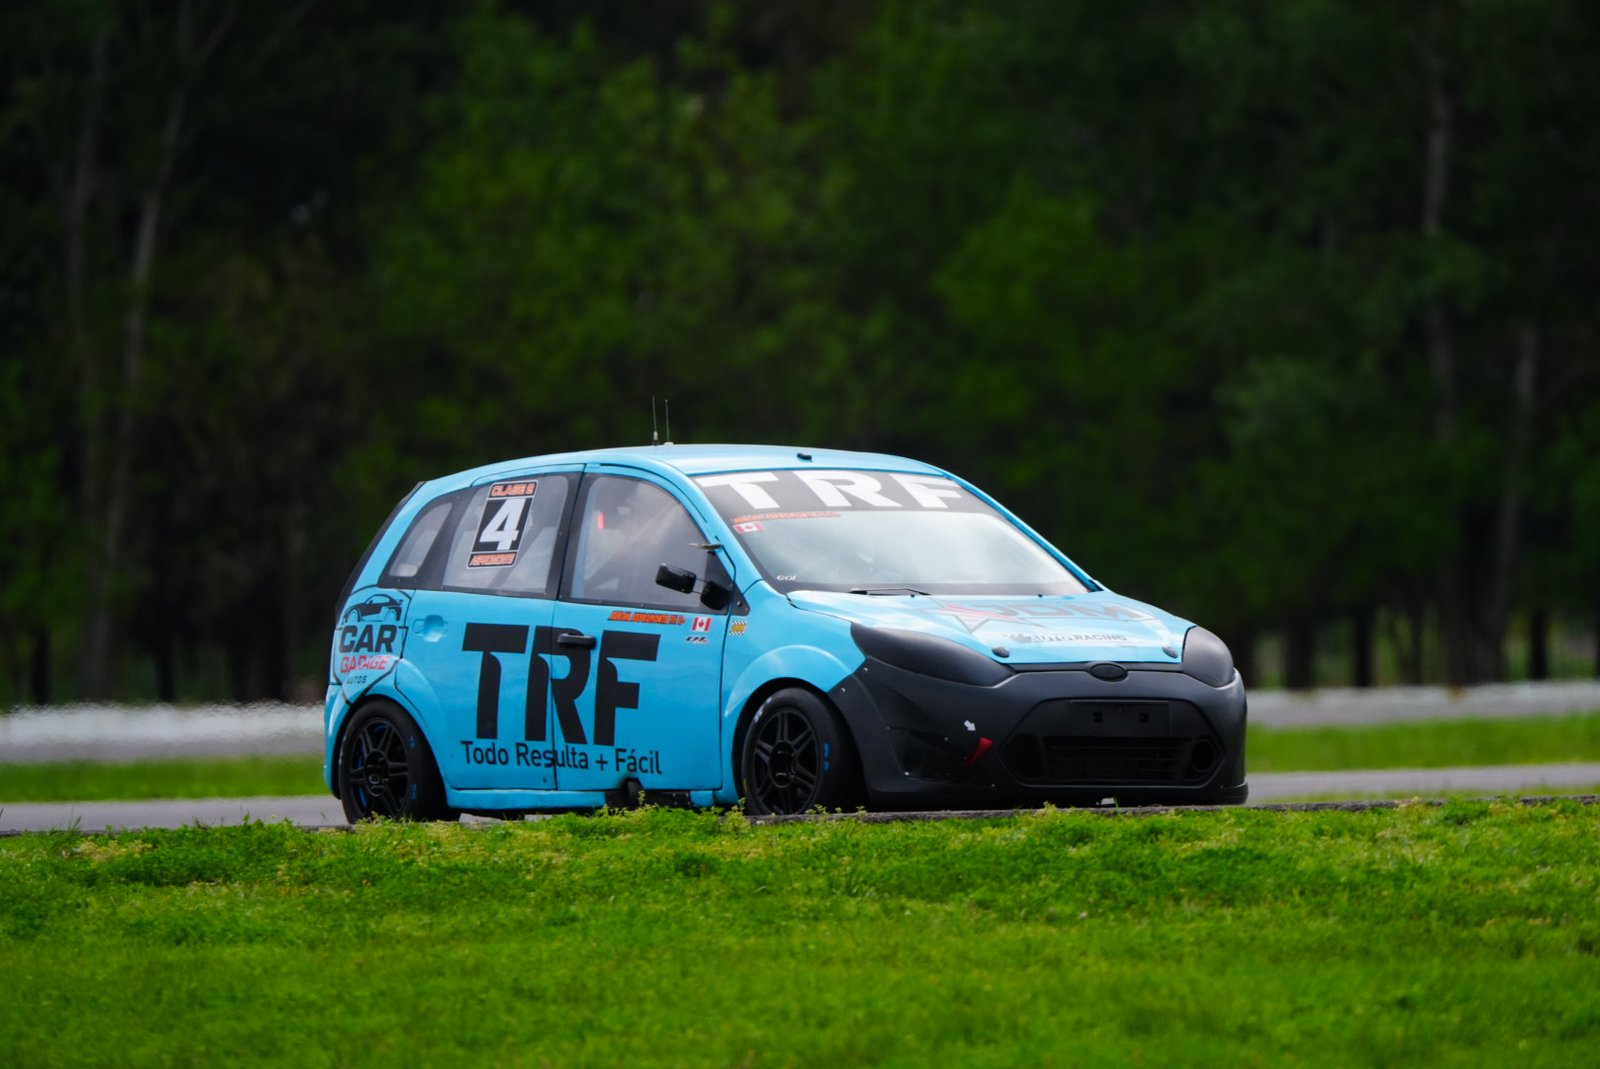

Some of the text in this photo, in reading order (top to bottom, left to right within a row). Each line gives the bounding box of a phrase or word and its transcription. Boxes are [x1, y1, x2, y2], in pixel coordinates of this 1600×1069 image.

[695, 470, 963, 509] TRF
[479, 498, 527, 551] 4
[339, 624, 397, 653] CAR
[340, 655, 392, 674] GARAGE
[462, 622, 661, 747] TRF
[460, 740, 663, 775] Todo Resulta + Fácil
